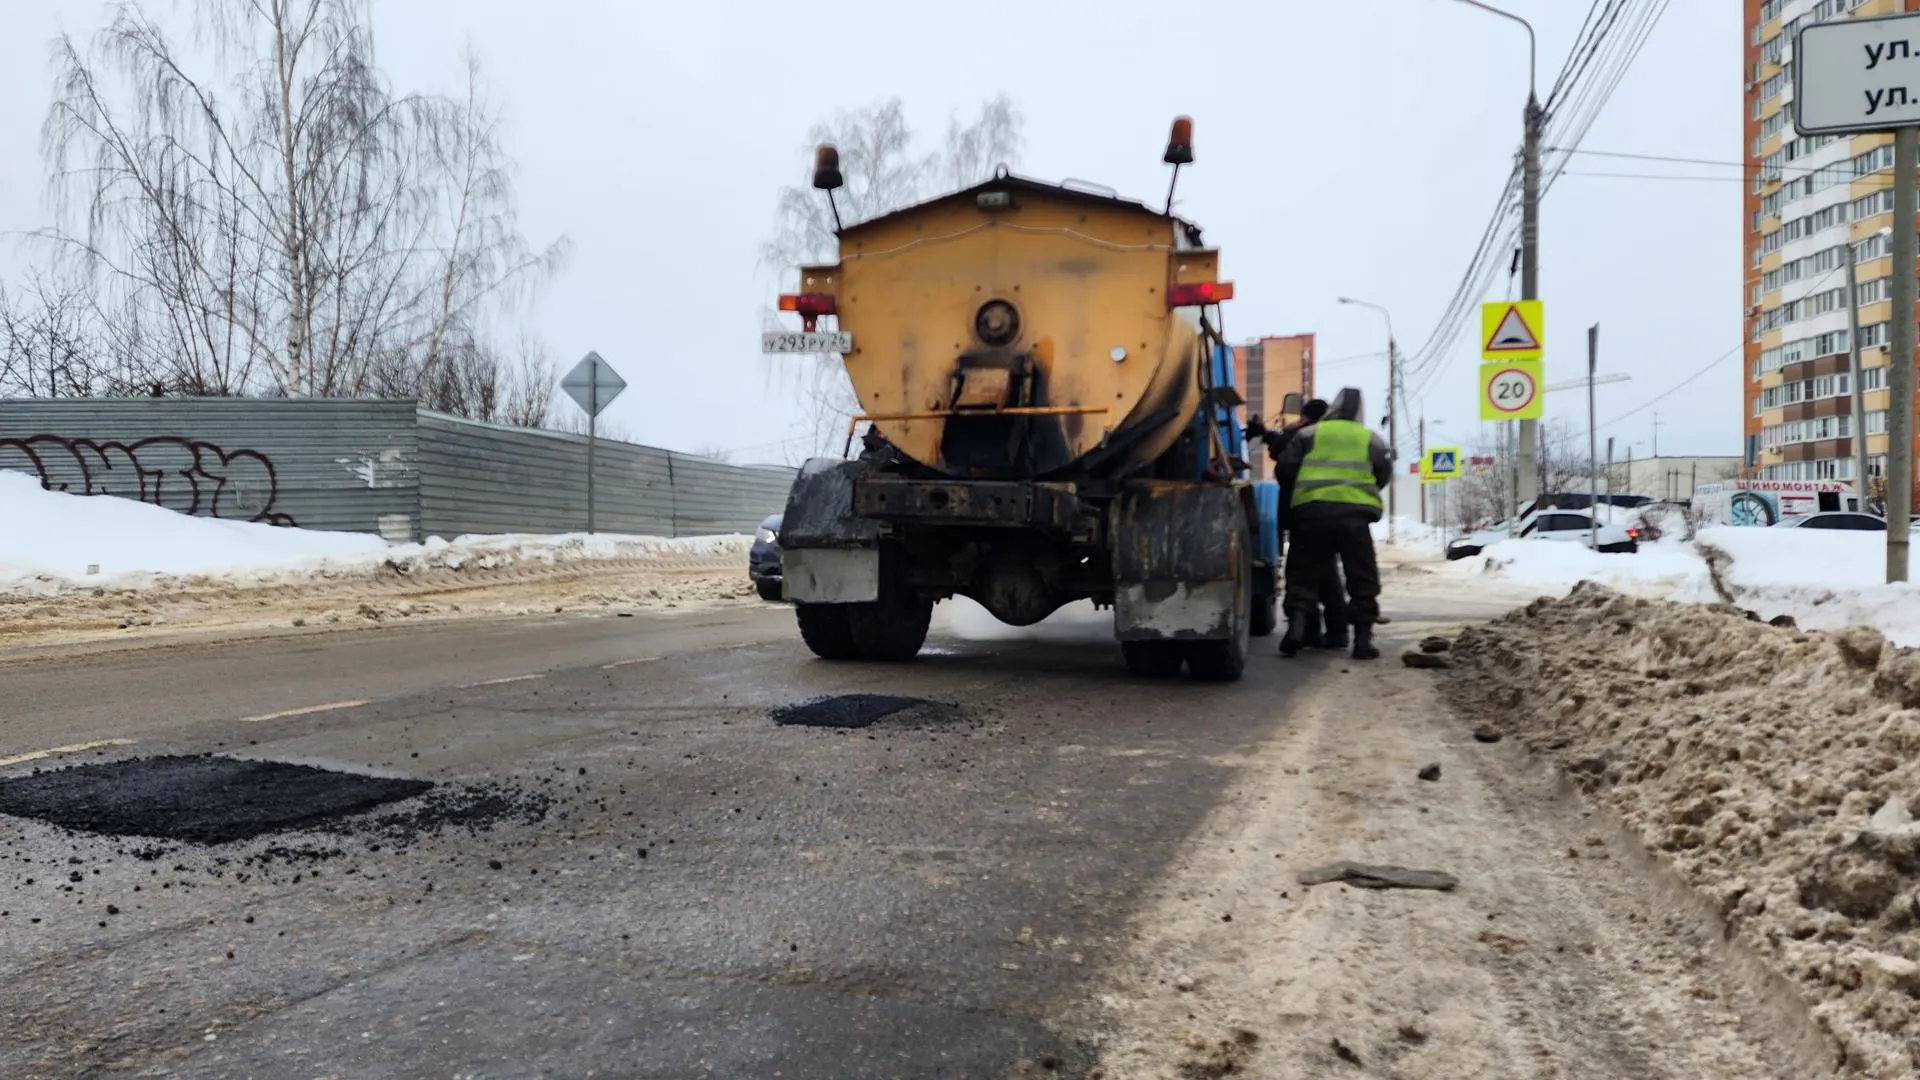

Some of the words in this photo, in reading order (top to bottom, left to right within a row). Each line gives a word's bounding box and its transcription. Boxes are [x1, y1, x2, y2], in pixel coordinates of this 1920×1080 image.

[1864, 40, 1920, 70] ул.
[1864, 86, 1918, 115] ул.
[1497, 382, 1525, 399] 20
[1736, 481, 1844, 492] ШИНОМОНТАЖ
